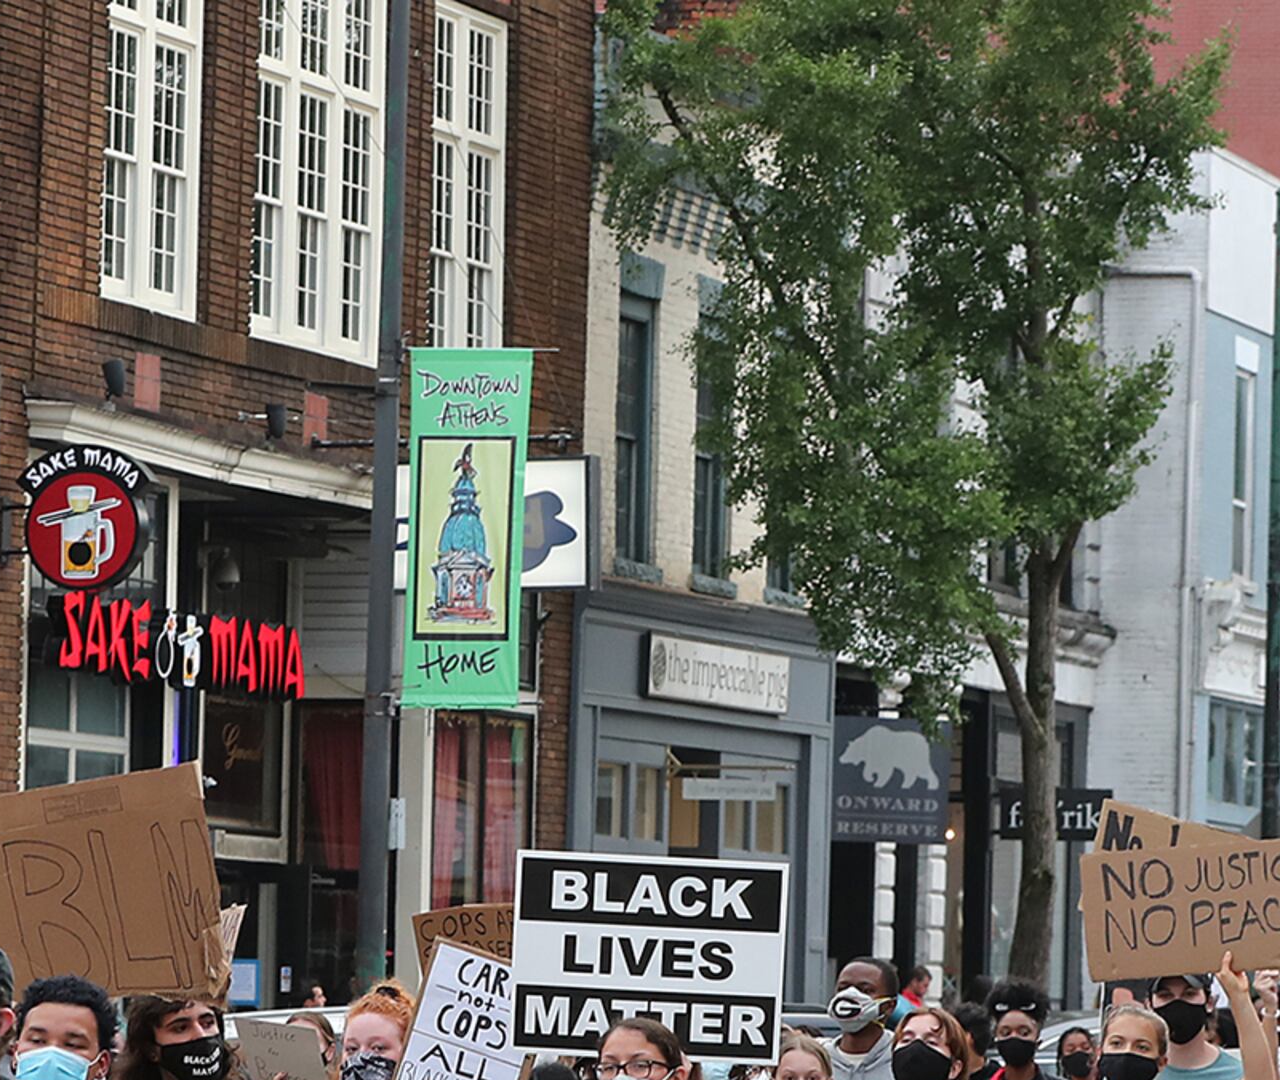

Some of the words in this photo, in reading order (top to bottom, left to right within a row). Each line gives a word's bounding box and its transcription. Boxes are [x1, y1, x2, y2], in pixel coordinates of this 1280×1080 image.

[25, 448, 77, 488] SAKE
[83, 448, 139, 488] MAMA
[59, 591, 150, 681] SAKE
[210, 614, 304, 698] MAMA
[417, 643, 500, 683] HOME
[669, 642, 690, 684] the
[692, 651, 766, 698] impeccable
[767, 665, 787, 708] pig
[837, 795, 939, 812] ONWARD
[1008, 801, 1100, 829] f'rik
[836, 821, 939, 838] RESERVE
[551, 870, 754, 920] BLACK
[1101, 858, 1173, 901] NO
[2, 819, 220, 990] BLM
[420, 912, 487, 942] COPS
[1105, 904, 1177, 953] NO
[562, 934, 734, 980] LIVES
[457, 958, 512, 1001] CAR
[458, 989, 495, 1013] not
[250, 1021, 296, 1041] Justice
[437, 1004, 507, 1050] COPS
